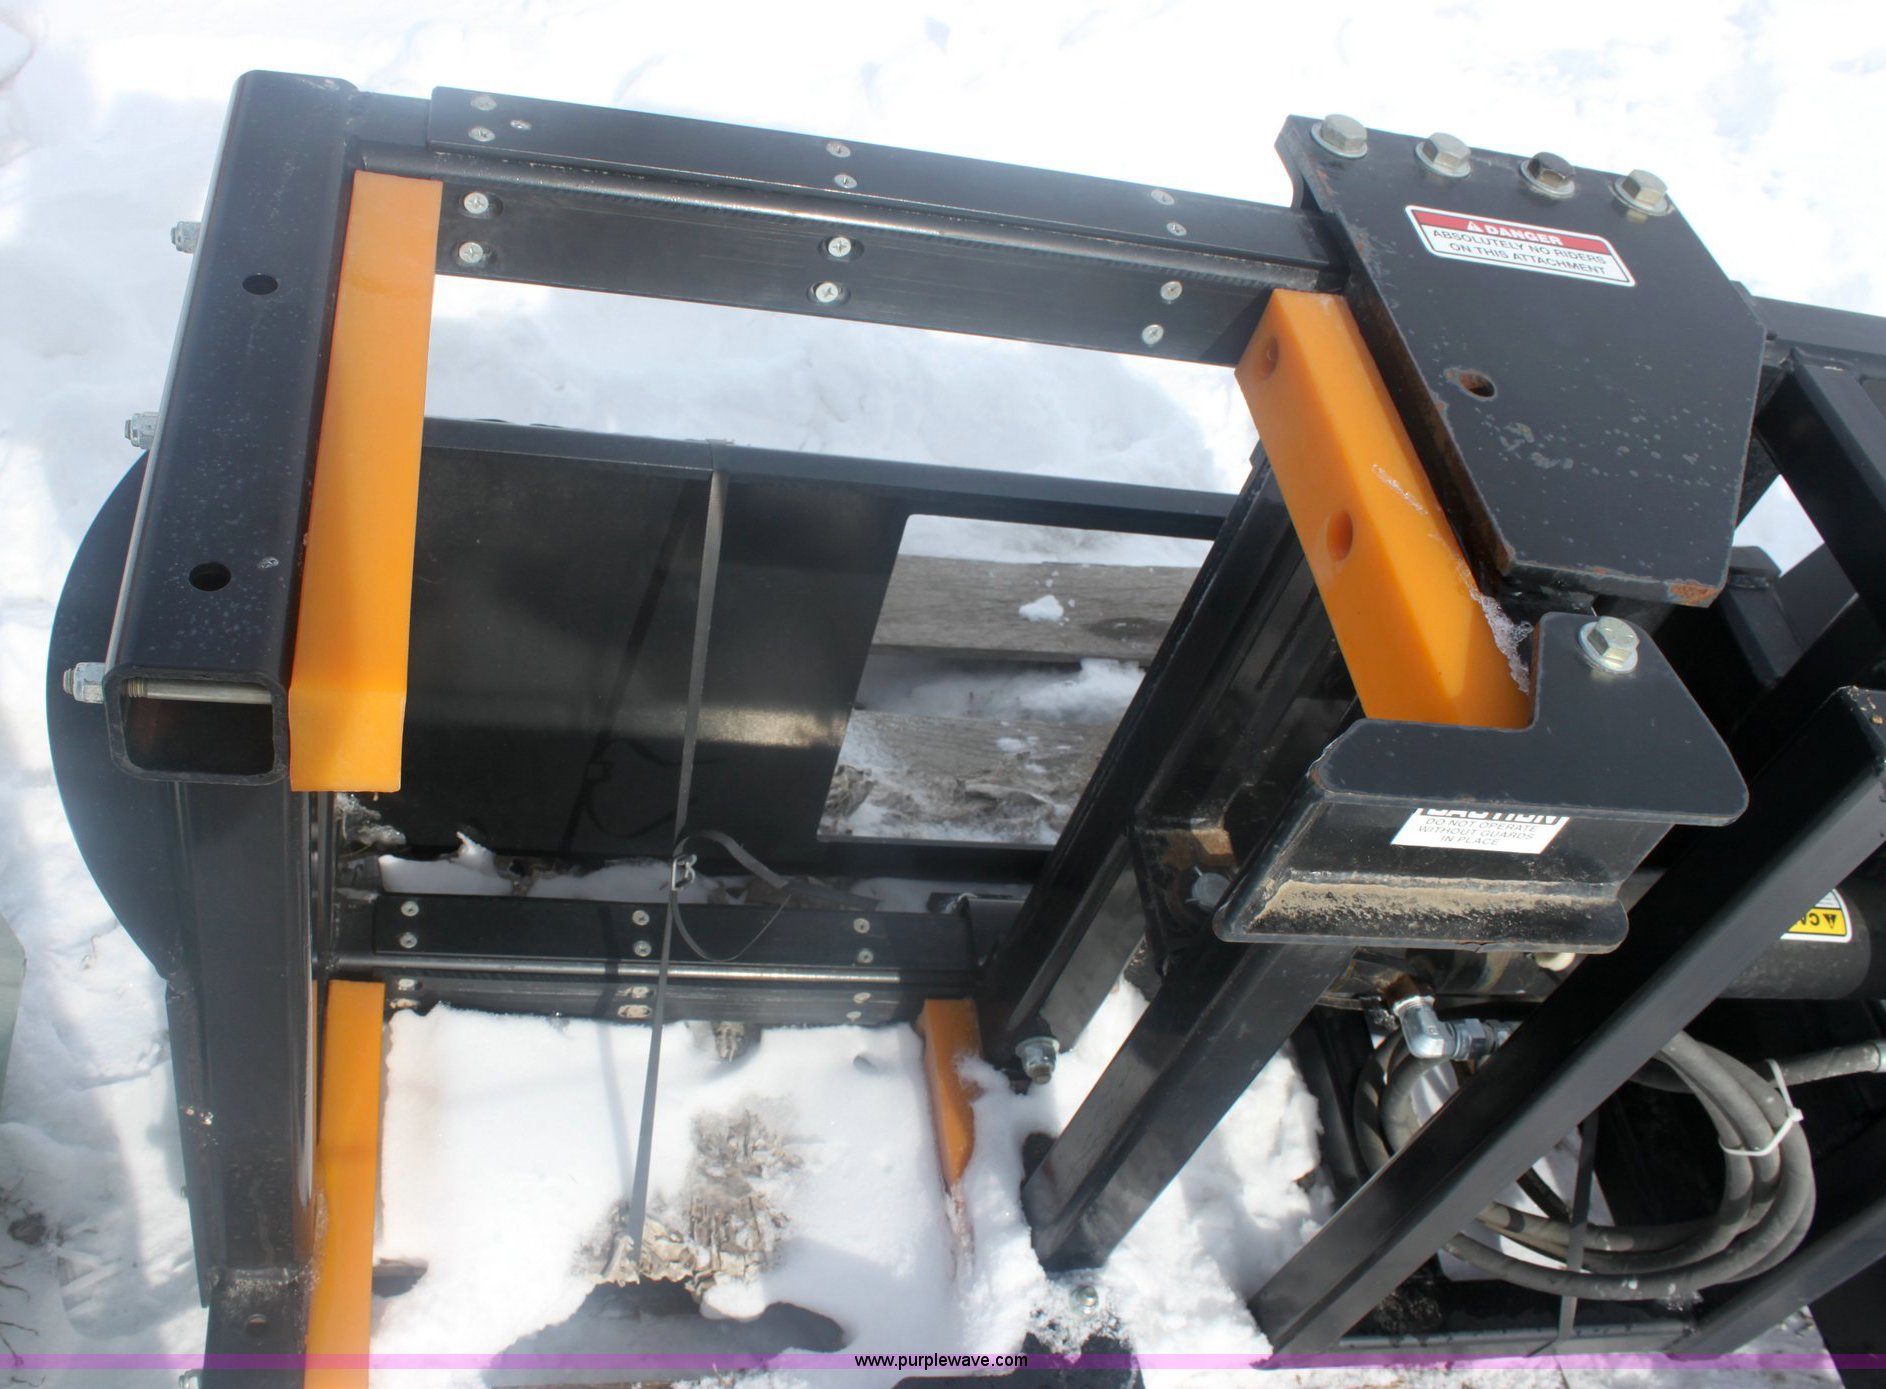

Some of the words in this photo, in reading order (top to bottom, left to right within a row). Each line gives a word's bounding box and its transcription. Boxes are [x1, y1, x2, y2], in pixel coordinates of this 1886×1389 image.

[1484, 225, 1564, 246] DANGER
[1433, 229, 1525, 251] ABSOLUTELY
[1528, 243, 1551, 256] NO
[1553, 248, 1607, 265] RIDERS
[1449, 242, 1472, 253] ON
[1474, 245, 1509, 259] THIS
[1513, 252, 1606, 275] ATTACHMENT
[1419, 825, 1477, 836] WITHOUT
[1480, 829, 1535, 840] GUARDS
[1426, 817, 1446, 826] DO
[1448, 819, 1478, 828] NOT
[1479, 821, 1537, 833] OPERATE
[1440, 834, 1453, 842] IN
[1456, 836, 1500, 846] PLACE
